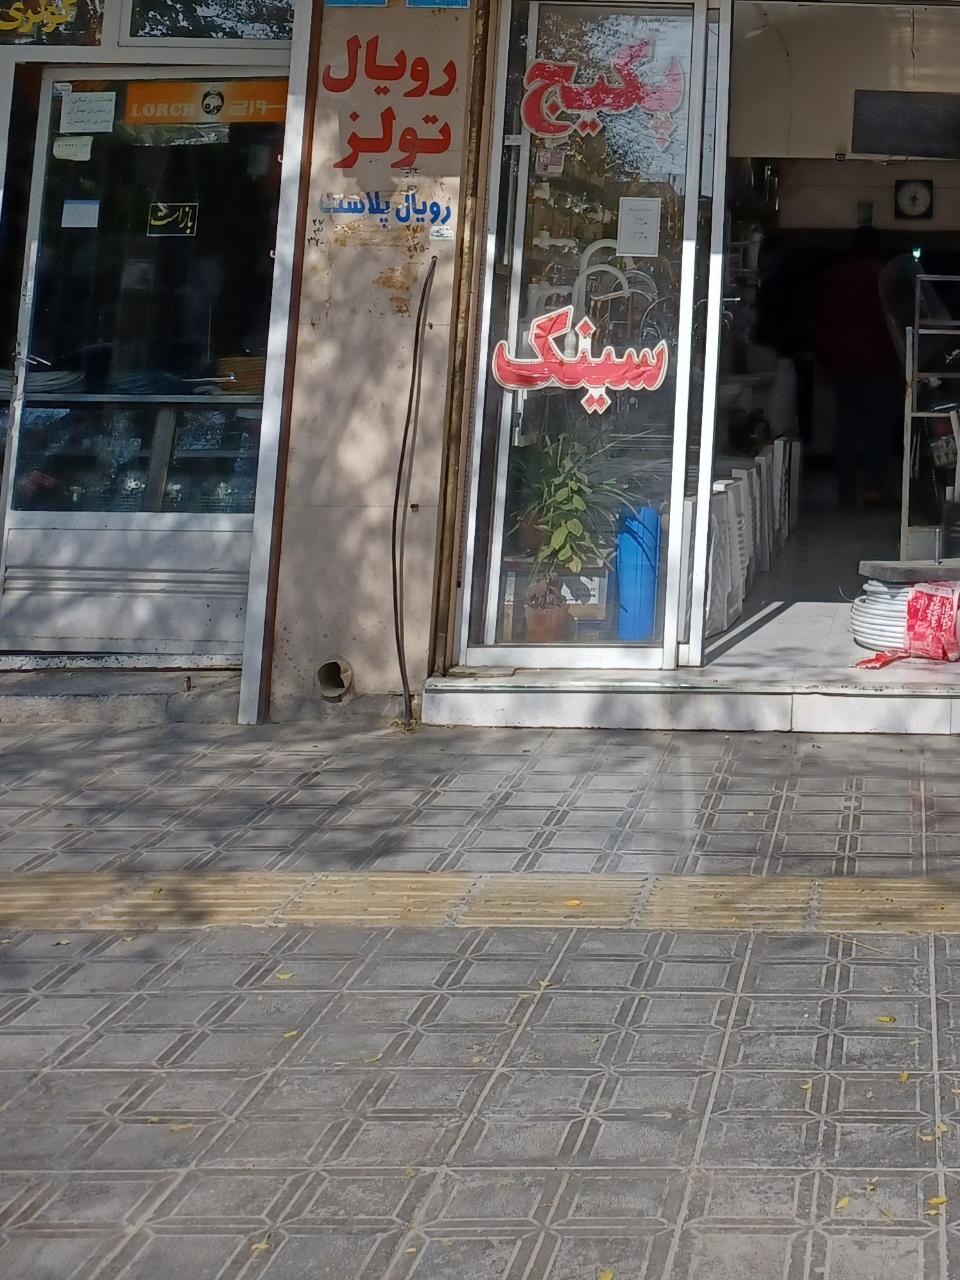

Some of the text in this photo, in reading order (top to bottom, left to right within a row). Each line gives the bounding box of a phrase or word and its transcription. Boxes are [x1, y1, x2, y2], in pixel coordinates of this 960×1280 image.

[322, 34, 457, 97] رویال
[521, 38, 684, 150] پکیج
[333, 106, 452, 169] تولز
[396, 192, 452, 225] رویال
[492, 306, 668, 414] سینک
